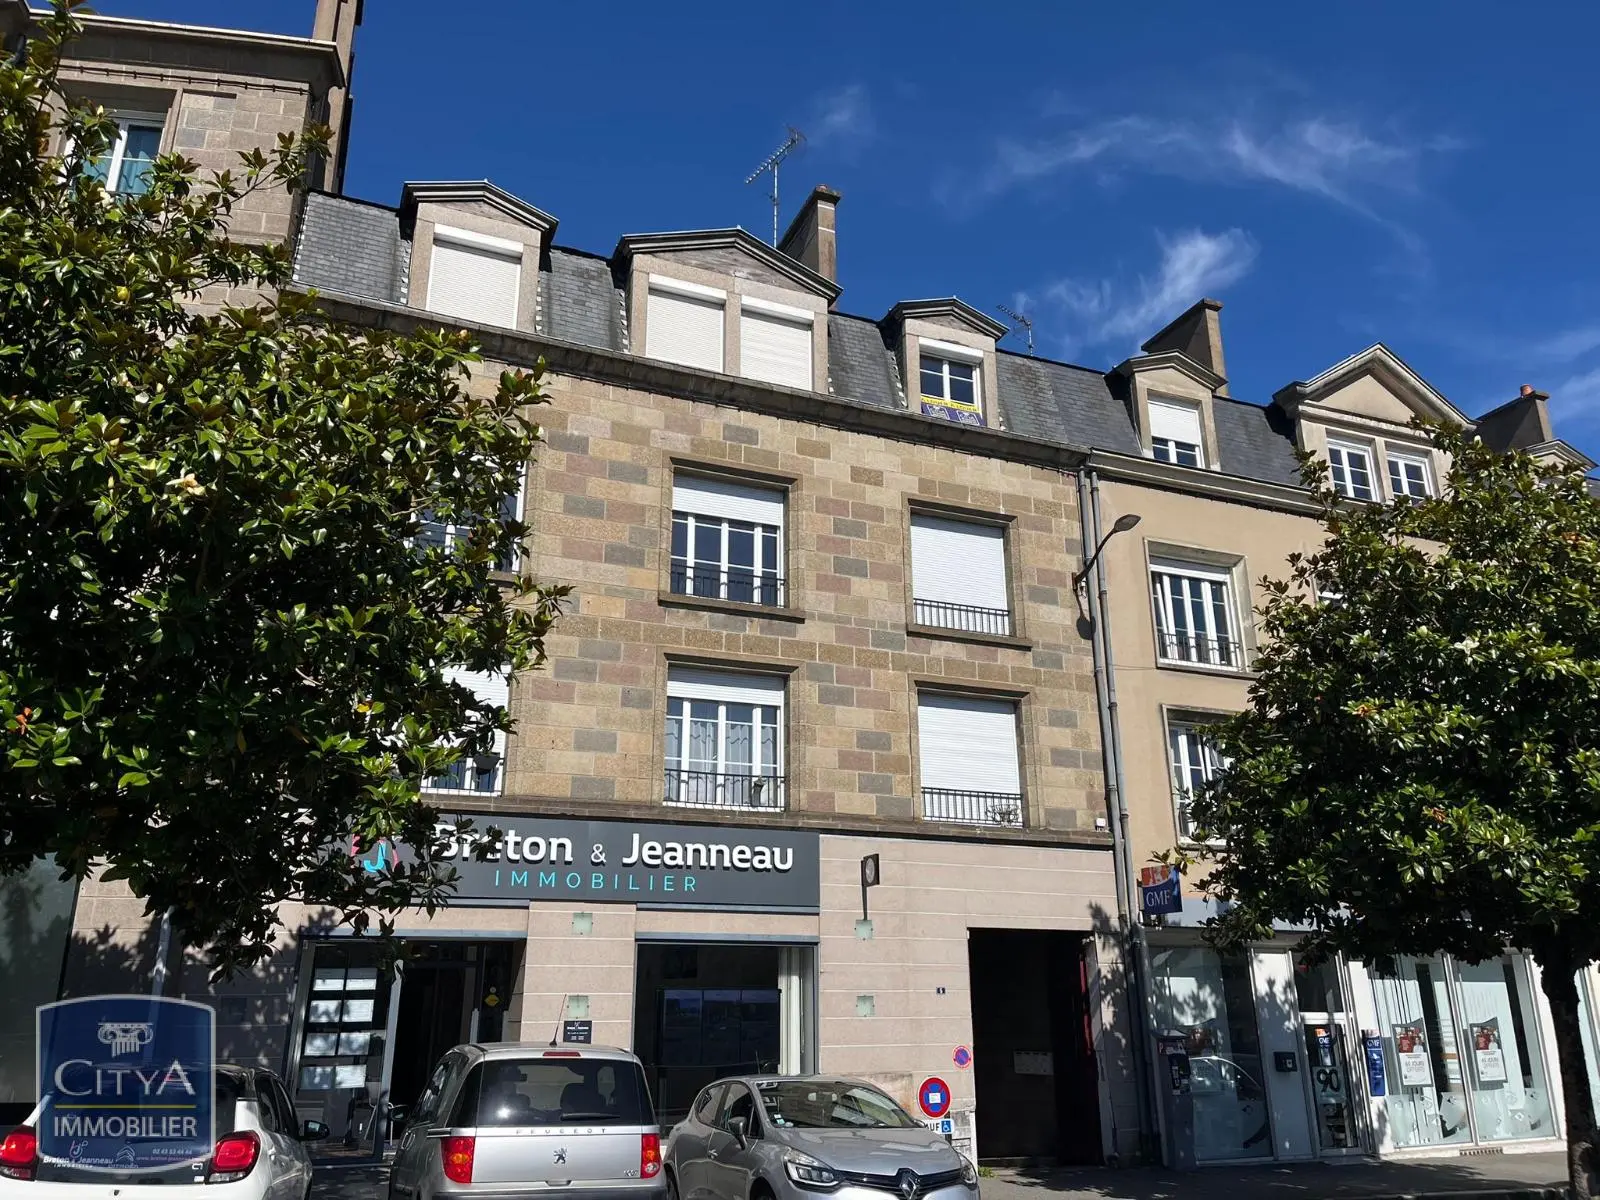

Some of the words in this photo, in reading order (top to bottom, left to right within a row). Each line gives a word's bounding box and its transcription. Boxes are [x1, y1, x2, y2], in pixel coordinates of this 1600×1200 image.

[590, 843, 607, 863] &
[622, 832, 794, 871] Jeanneau
[495, 869, 697, 892] IMMOBILIER
[1146, 890, 1170, 907] GMF
[516, 1127, 606, 1135] PEUGEOT
